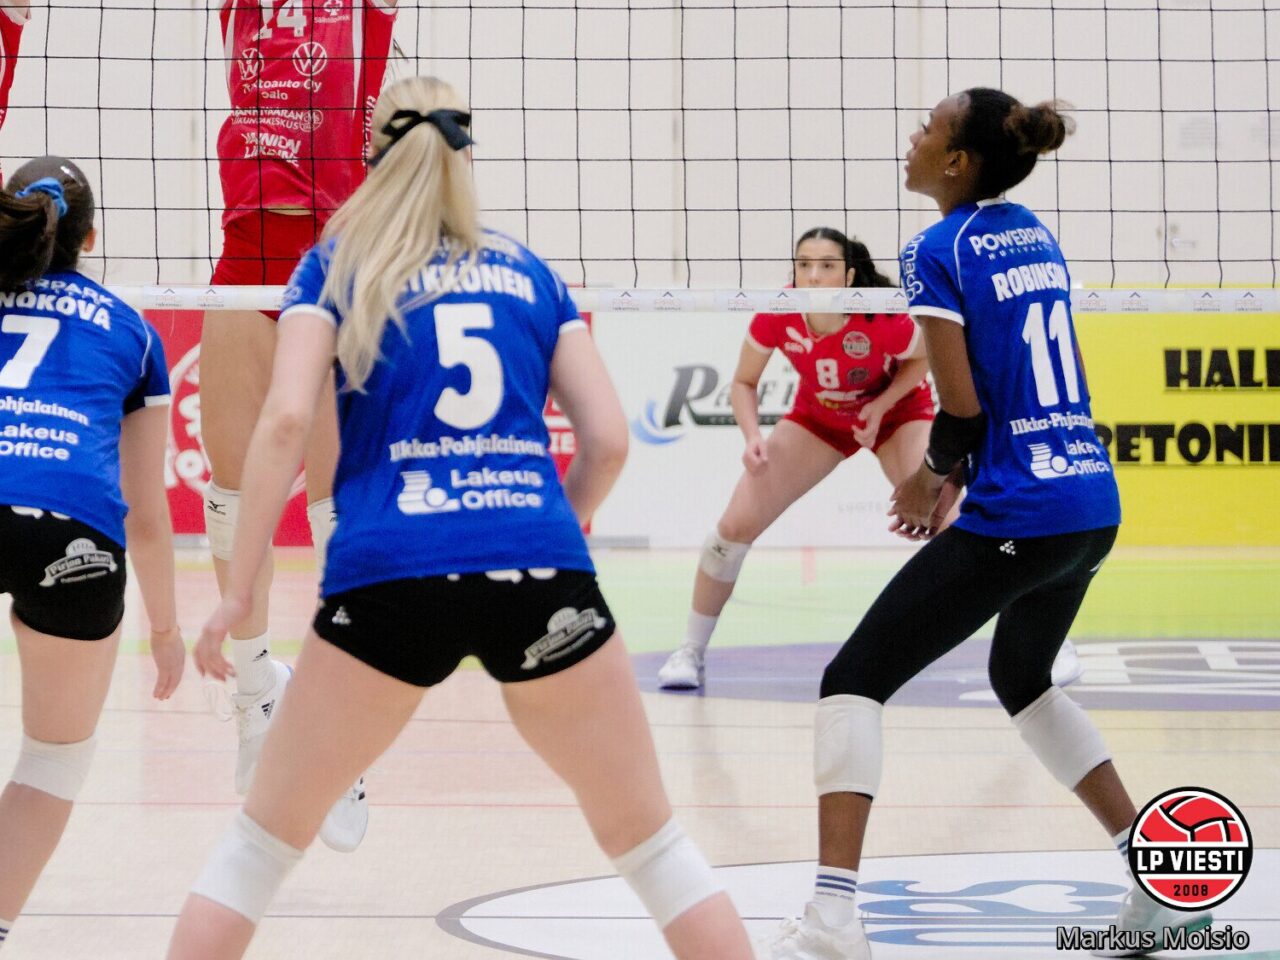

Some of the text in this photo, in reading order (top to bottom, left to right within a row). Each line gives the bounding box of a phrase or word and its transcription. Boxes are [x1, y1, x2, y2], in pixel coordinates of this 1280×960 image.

[433, 302, 505, 430] 5
[1021, 300, 1081, 407] 11
[815, 358, 840, 389] 8
[389, 433, 546, 463] Ilkka-Pohjalainen
[450, 468, 543, 488] Lakeus
[461, 488, 542, 509] Office
